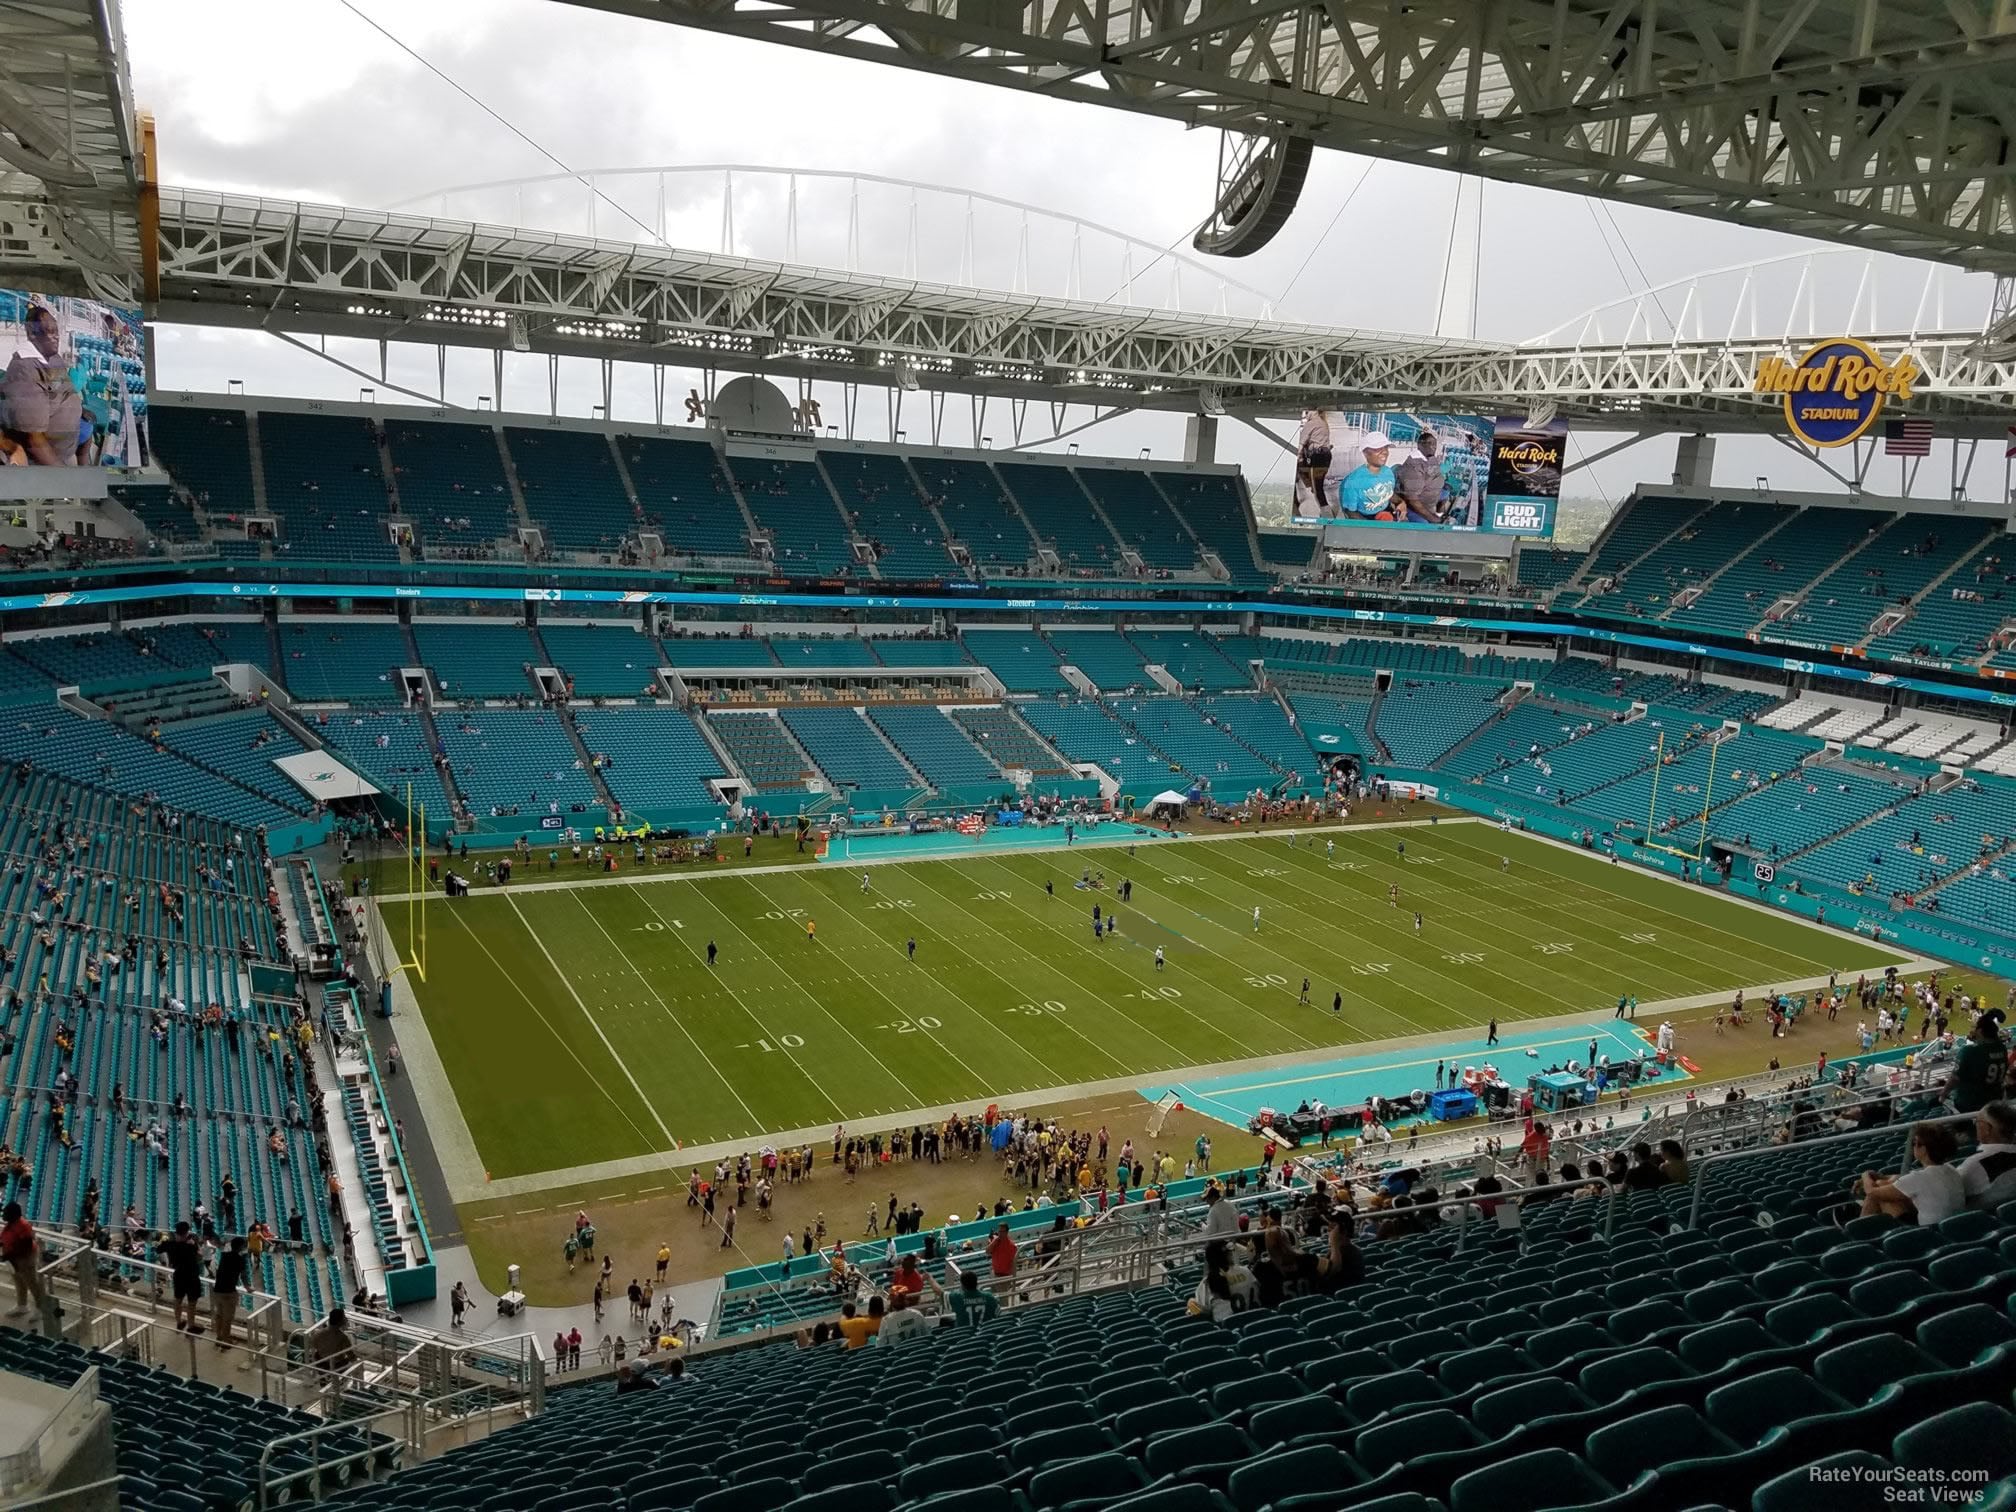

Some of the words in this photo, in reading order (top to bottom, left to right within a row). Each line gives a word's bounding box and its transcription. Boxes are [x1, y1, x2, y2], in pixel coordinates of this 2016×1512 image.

[1754, 355, 1838, 393] Hard
[1833, 354, 1918, 400] Rock
[180, 394, 194, 403] 341
[309, 402, 323, 410] 342
[1801, 408, 1860, 420] STADIUM
[765, 447, 778, 456] 346
[1498, 446, 1529, 460] Hard
[1529, 447, 1557, 463] Rock
[1503, 505, 1536, 517] BUD
[1496, 515, 1541, 528] LIGHT
[740, 597, 777, 605] Dolphins
[1816, 643, 1826, 651] 75
[1914, 657, 1940, 668] TAYLOR
[1942, 661, 1952, 670] 99
[1632, 851, 1665, 866] Dolphins
[1757, 866, 1771, 879] 25
[1857, 918, 1899, 938] Dolhins
[1532, 942, 1573, 954] 20
[1441, 952, 1484, 964] 30
[1350, 962, 1389, 975] 40
[1243, 974, 1288, 988] 50
[1141, 986, 1182, 1001] 40
[1019, 1000, 1067, 1016] 30
[890, 1016, 942, 1034] 20
[755, 1034, 805, 1053] 10
[965, 1304, 986, 1330] 17
